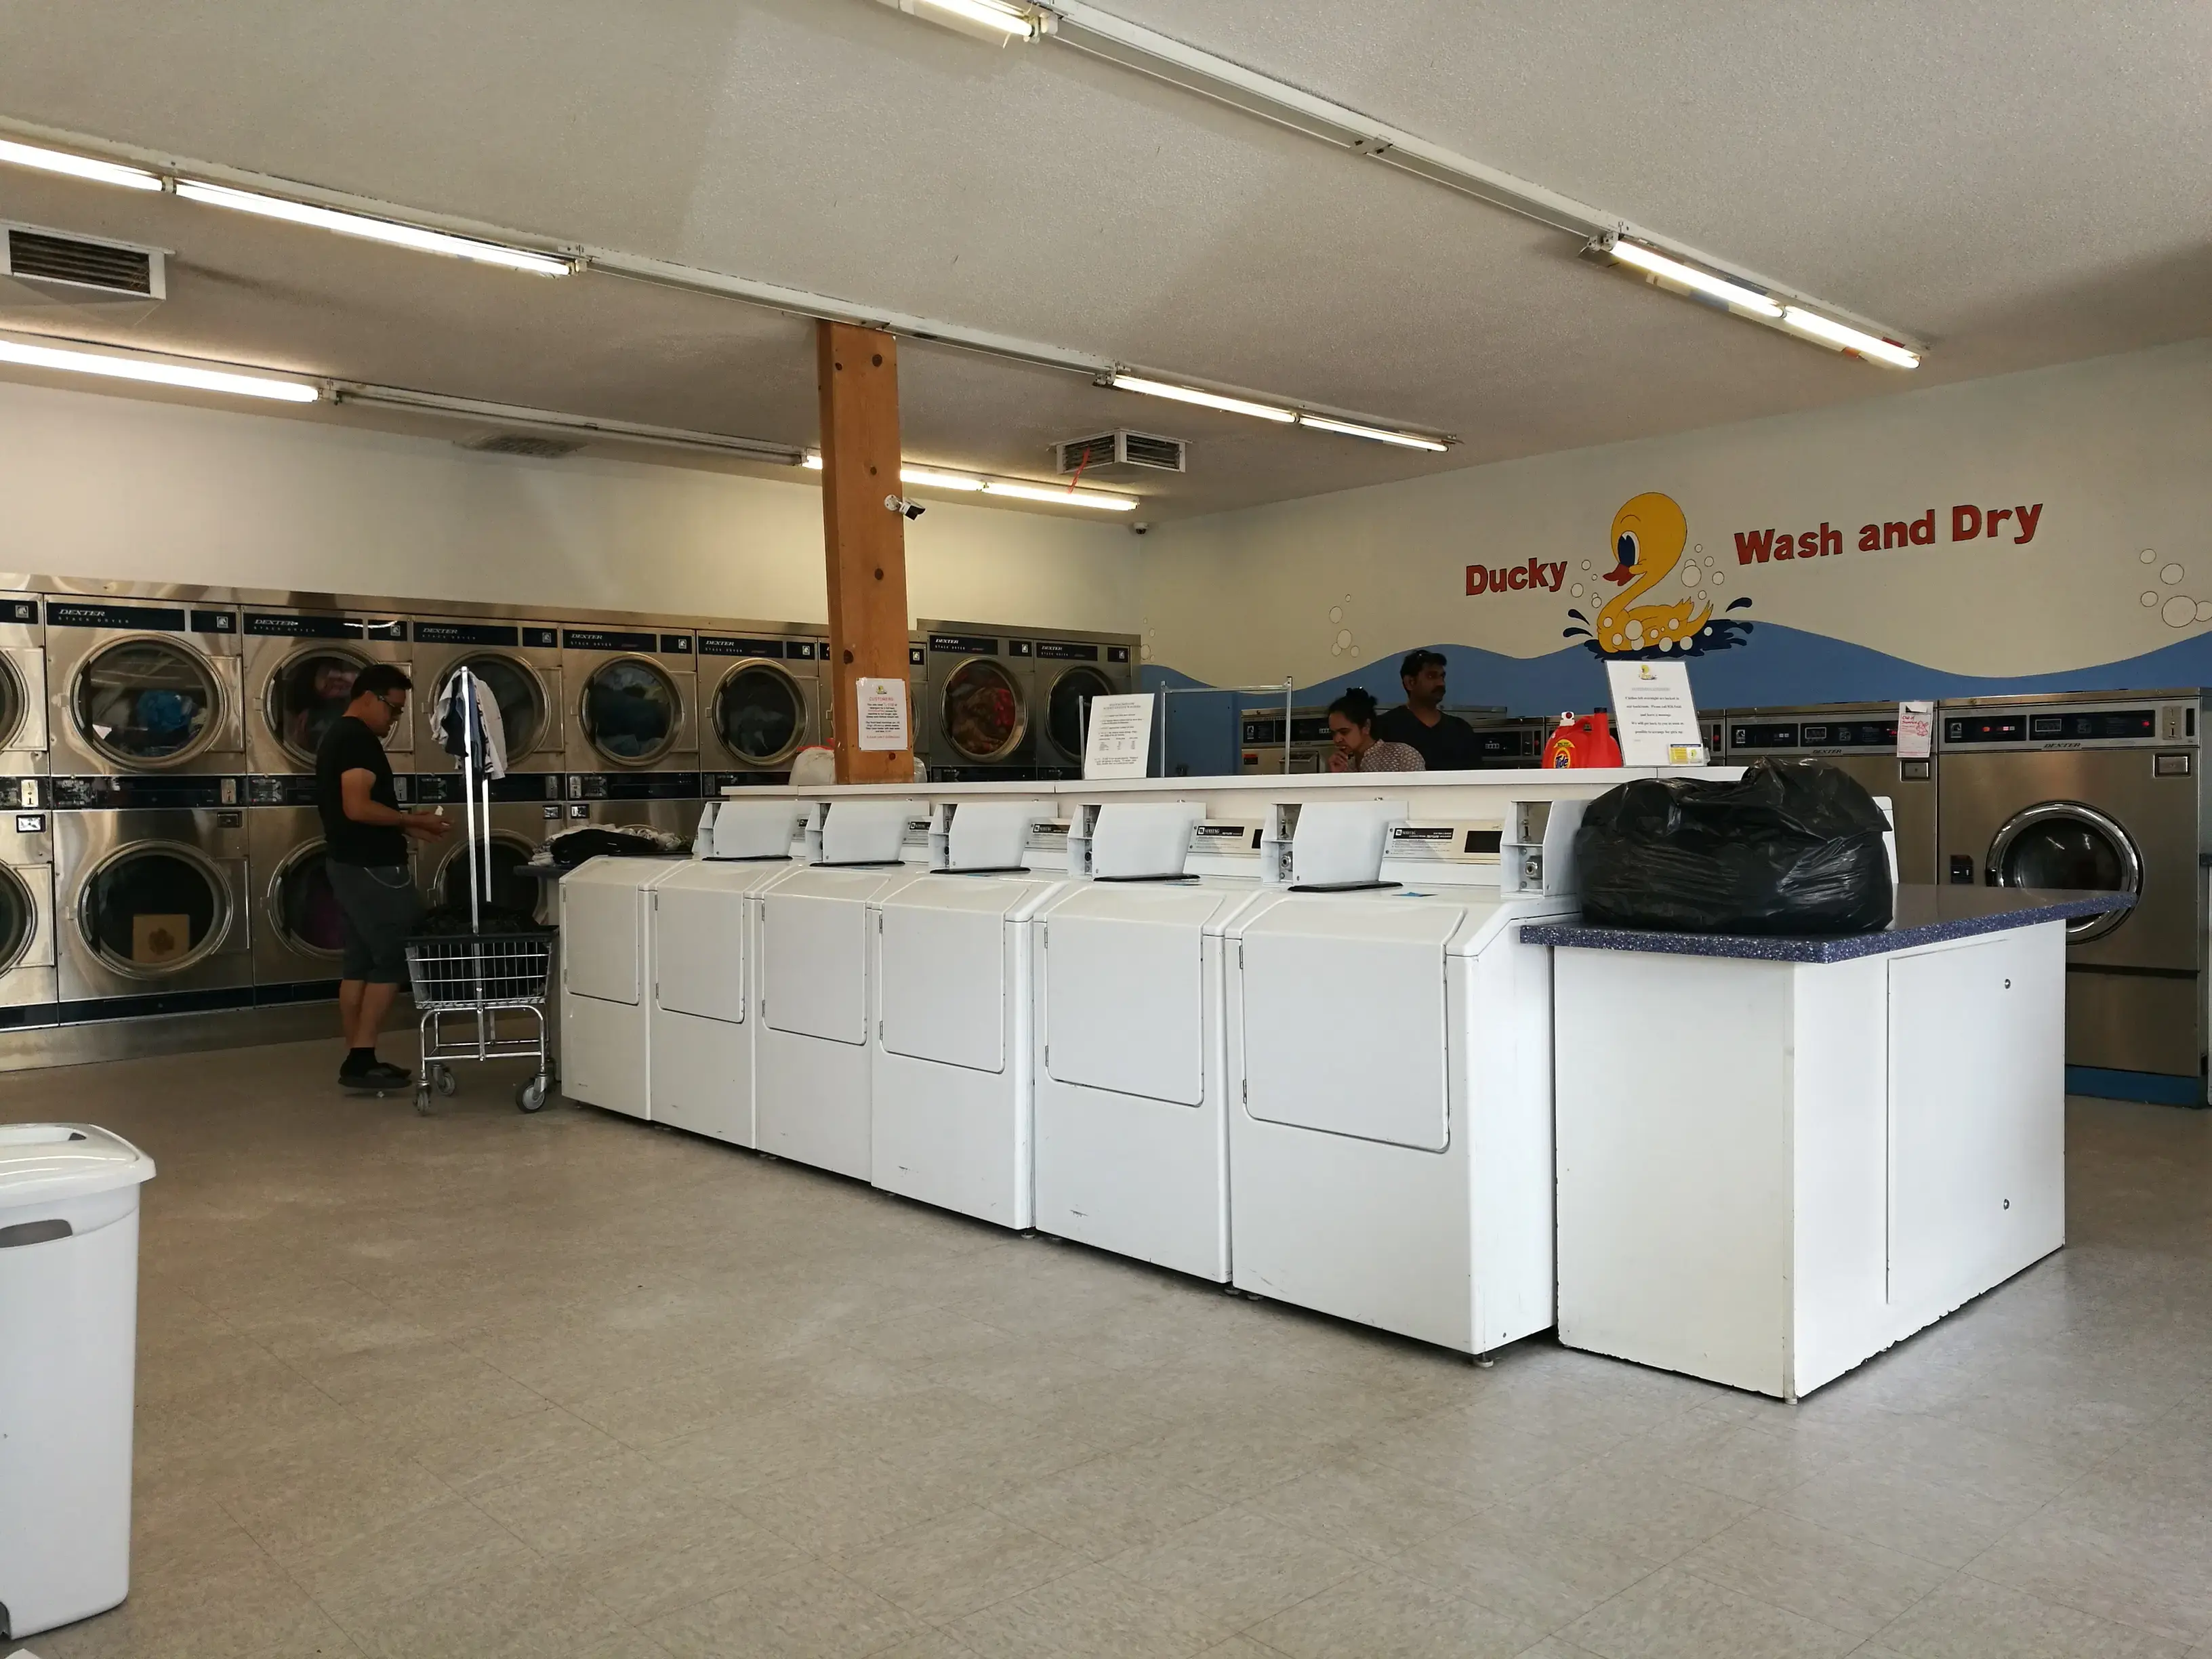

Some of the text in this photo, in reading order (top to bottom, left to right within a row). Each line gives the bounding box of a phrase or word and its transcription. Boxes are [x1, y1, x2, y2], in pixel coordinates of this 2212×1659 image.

[1465, 503, 2043, 596] Ducky Wash and Dry
[1555, 754, 1569, 769] Tide
